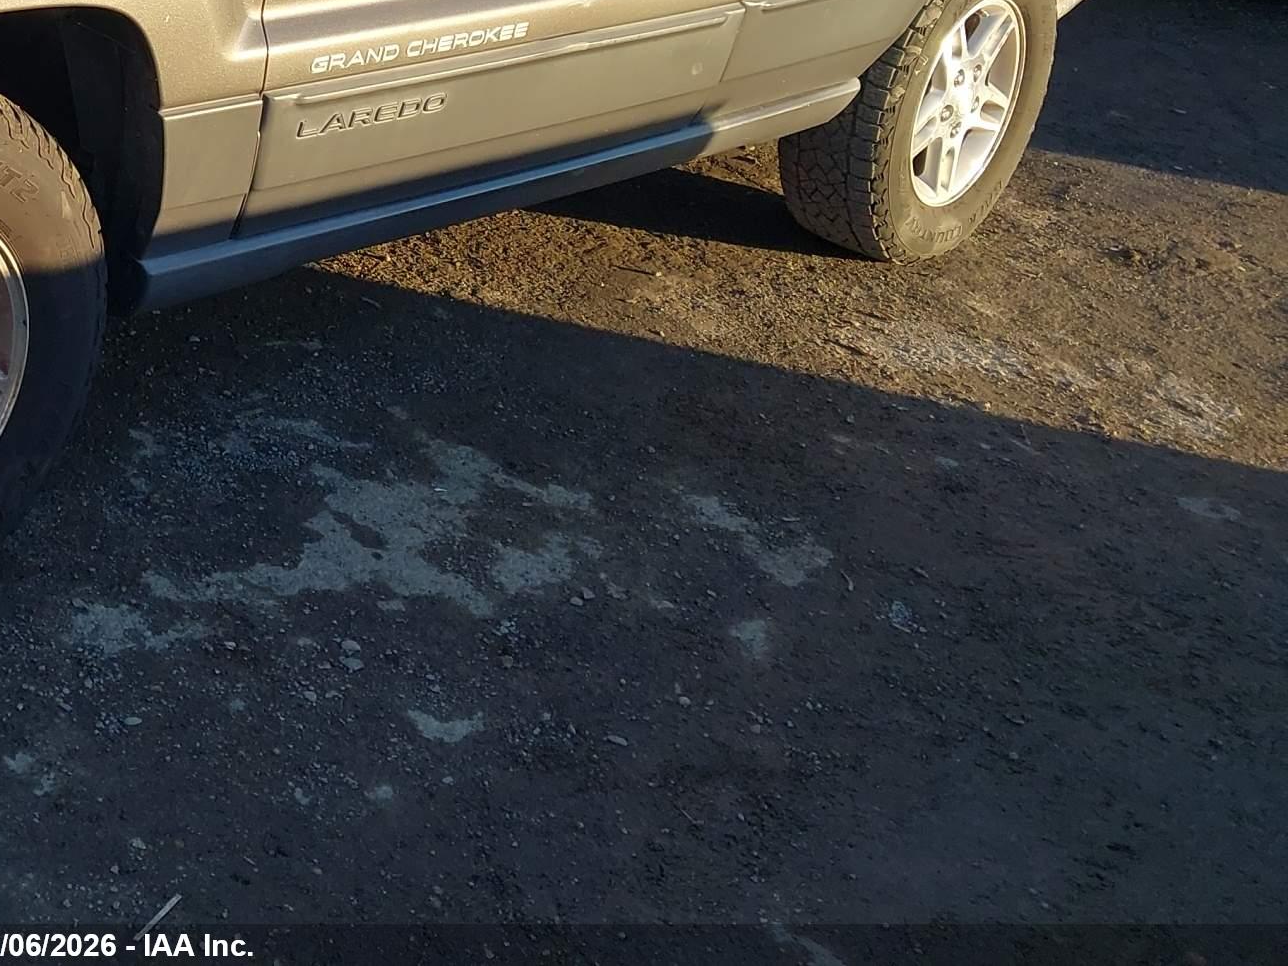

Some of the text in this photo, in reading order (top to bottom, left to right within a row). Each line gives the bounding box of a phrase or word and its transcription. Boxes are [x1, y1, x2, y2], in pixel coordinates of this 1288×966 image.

[310, 21, 530, 75] GRAND CHEROKEE
[295, 91, 448, 140] LAREDO
